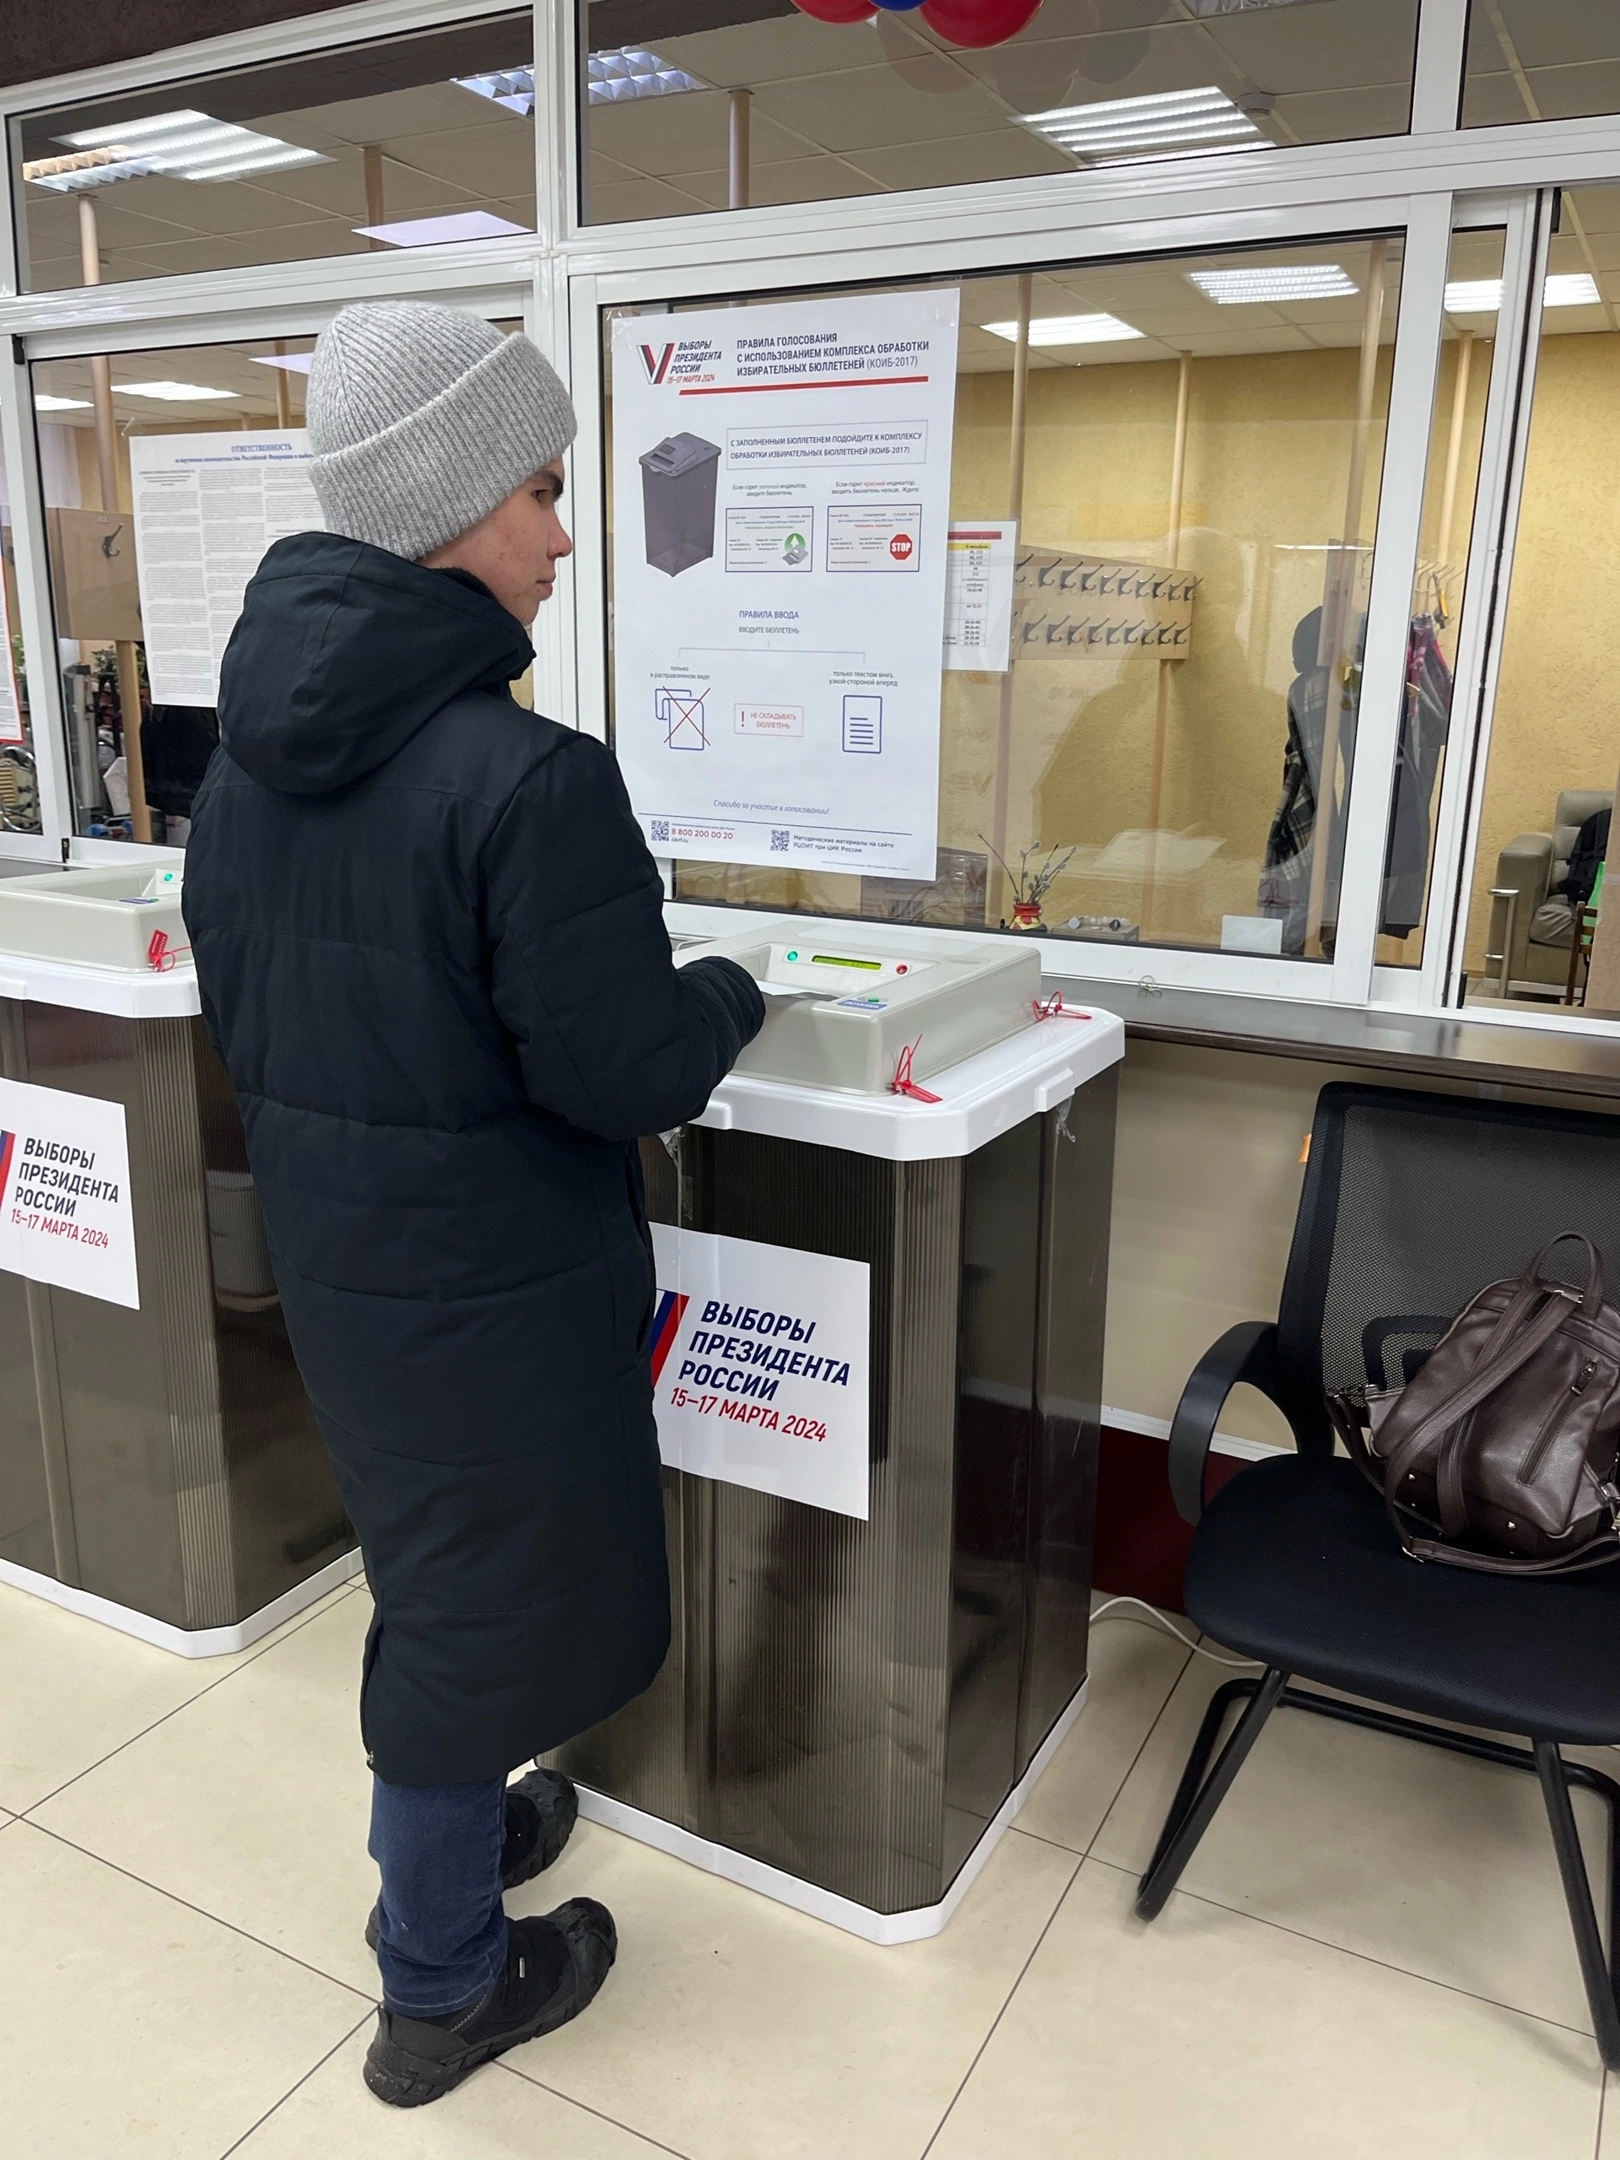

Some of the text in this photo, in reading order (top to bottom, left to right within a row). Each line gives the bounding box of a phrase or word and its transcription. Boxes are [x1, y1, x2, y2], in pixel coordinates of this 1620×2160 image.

[678, 340, 712, 351] ВЫБОРЫ
[736, 333, 837, 349] ПРАВИЛА ГОЛОСОВАНИЯ
[674, 351, 722, 363] ПРЕЗИДЕНТА
[737, 341, 929, 363] С ИСПОЛЬЗОВАНИЕМ КОМПЛЕКСА ОБРАБОТКИ
[670, 364, 701, 374] РОССИИ
[737, 356, 918, 377] ИЗБИРАТЕЛЬНЫХ БЮЛЛЕТЕНЕЙ (КОИБ-2017)
[682, 375, 701, 383] МАРТА
[701, 374, 715, 382] 2024
[730, 439, 735, 447] С
[736, 437, 785, 447] ЗАПОЛНЕННЫМ
[786, 436, 831, 445] БЮЛЛЕТЕНЕМ
[832, 434, 874, 443] ПОДОЙДИТЕ
[880, 432, 922, 441] КОМПЛЕКСУ
[730, 447, 910, 459] ОБРАБОТКИ ИЗБИРАТЕЛЬНЫХ БЮЛЛЕТЕНЕЙ (КОИБ-2017)
[891, 542, 911, 552] STOP
[739, 610, 799, 620] ПРАВИЛА ВВОДА
[739, 626, 800, 635] ВВОДИТЕ БЮЛЛЕТЕНЬ
[750, 712, 797, 722] НЕ СКЛАДЫВАТЬ
[756, 721, 790, 730] БЮЛЛЕТЕНЬ
[713, 799, 741, 810] Спасибо
[750, 804, 778, 812] участие
[678, 828, 693, 837] 800
[694, 830, 709, 838] 200
[711, 831, 722, 839] 00
[723, 832, 733, 840] 20
[793, 835, 835, 843] Методические
[827, 844, 840, 852] ЦИК
[23, 1137, 96, 1170] ВЫБОРЫ
[18, 1162, 119, 1203] ПРЕЗИДЕНТА
[15, 1186, 77, 1218] РОССИИ
[40, 1218, 79, 1241] МАРТА
[81, 1227, 109, 1249] 2024
[700, 1301, 817, 1344] ВЫБОРЫ
[688, 1331, 851, 1386] ПРЕЗИДЕНТА
[678, 1360, 780, 1401] РОССИИ
[718, 1399, 780, 1430] МАРТА
[781, 1415, 828, 1442] 2024
